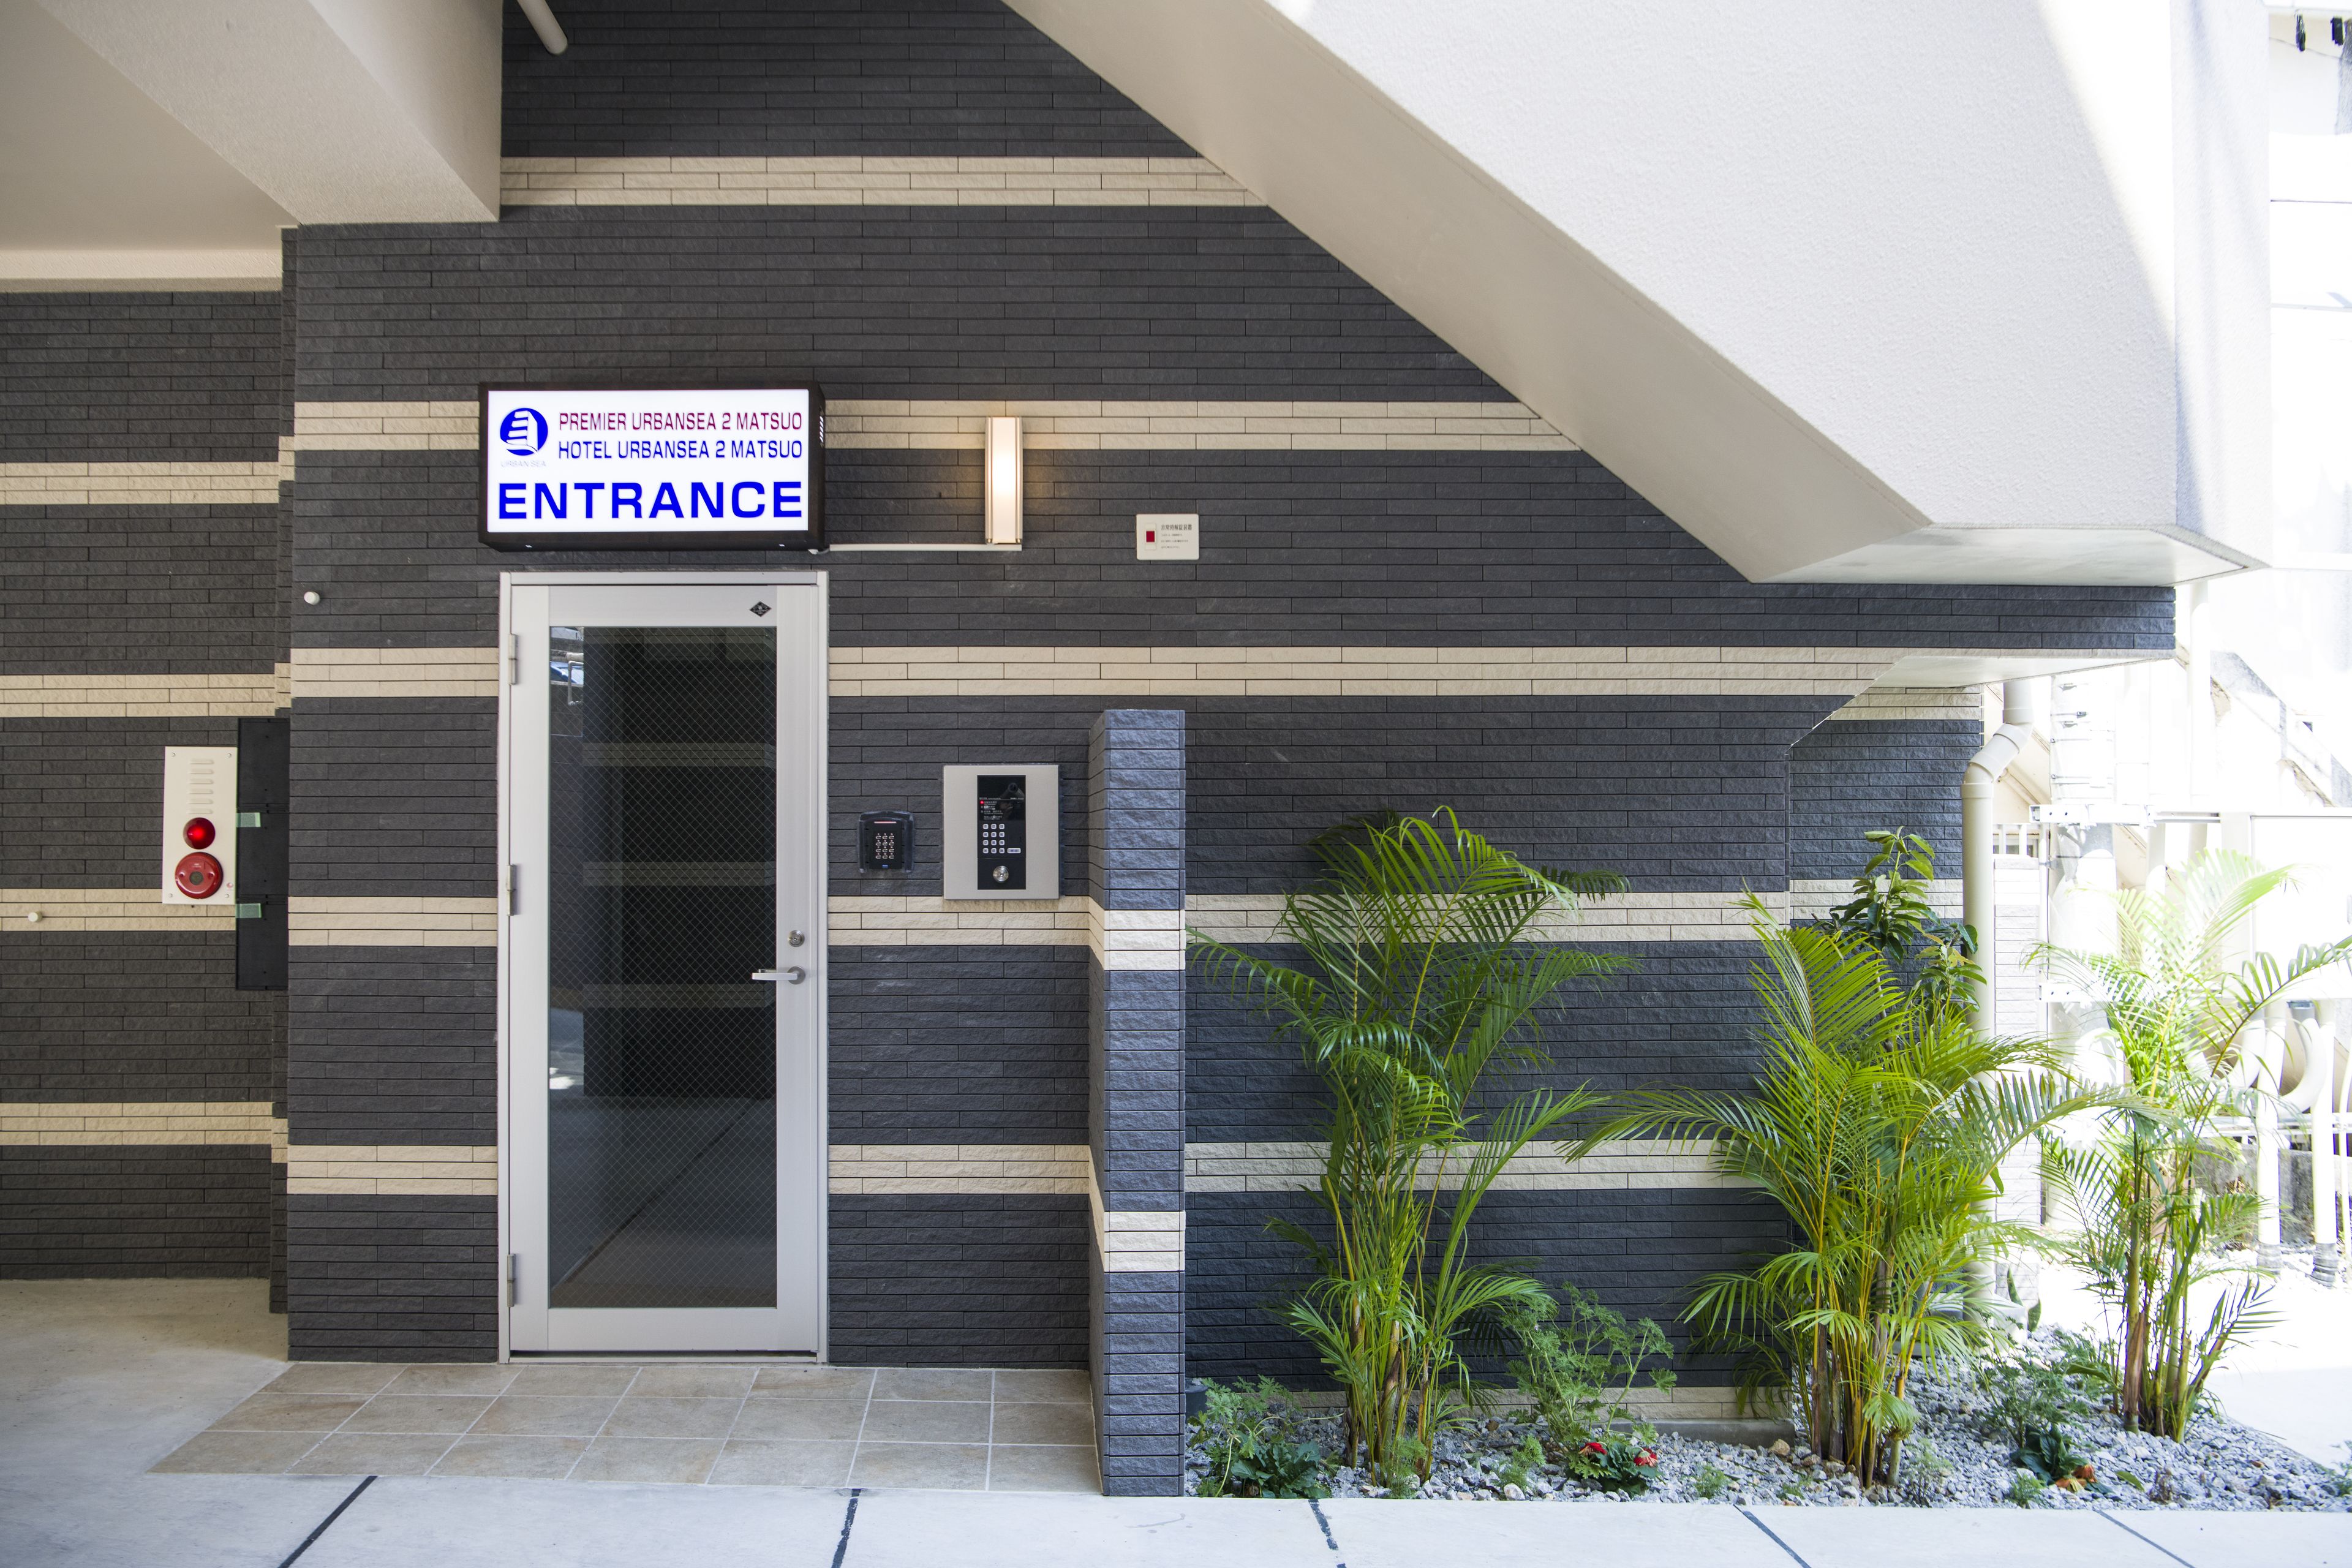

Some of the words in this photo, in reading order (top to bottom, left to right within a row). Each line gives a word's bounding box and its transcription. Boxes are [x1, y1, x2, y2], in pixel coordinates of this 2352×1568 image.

[560, 413, 627, 431] PREMIER
[632, 412, 717, 431] URBANSEA
[722, 412, 731, 430] 2
[737, 412, 802, 430] MATSUO
[559, 440, 612, 459] HOTEL
[618, 440, 710, 459] URBANSEA
[715, 440, 726, 459] 2
[731, 440, 802, 458] MATSUO
[498, 481, 802, 519] ENTRANCE
